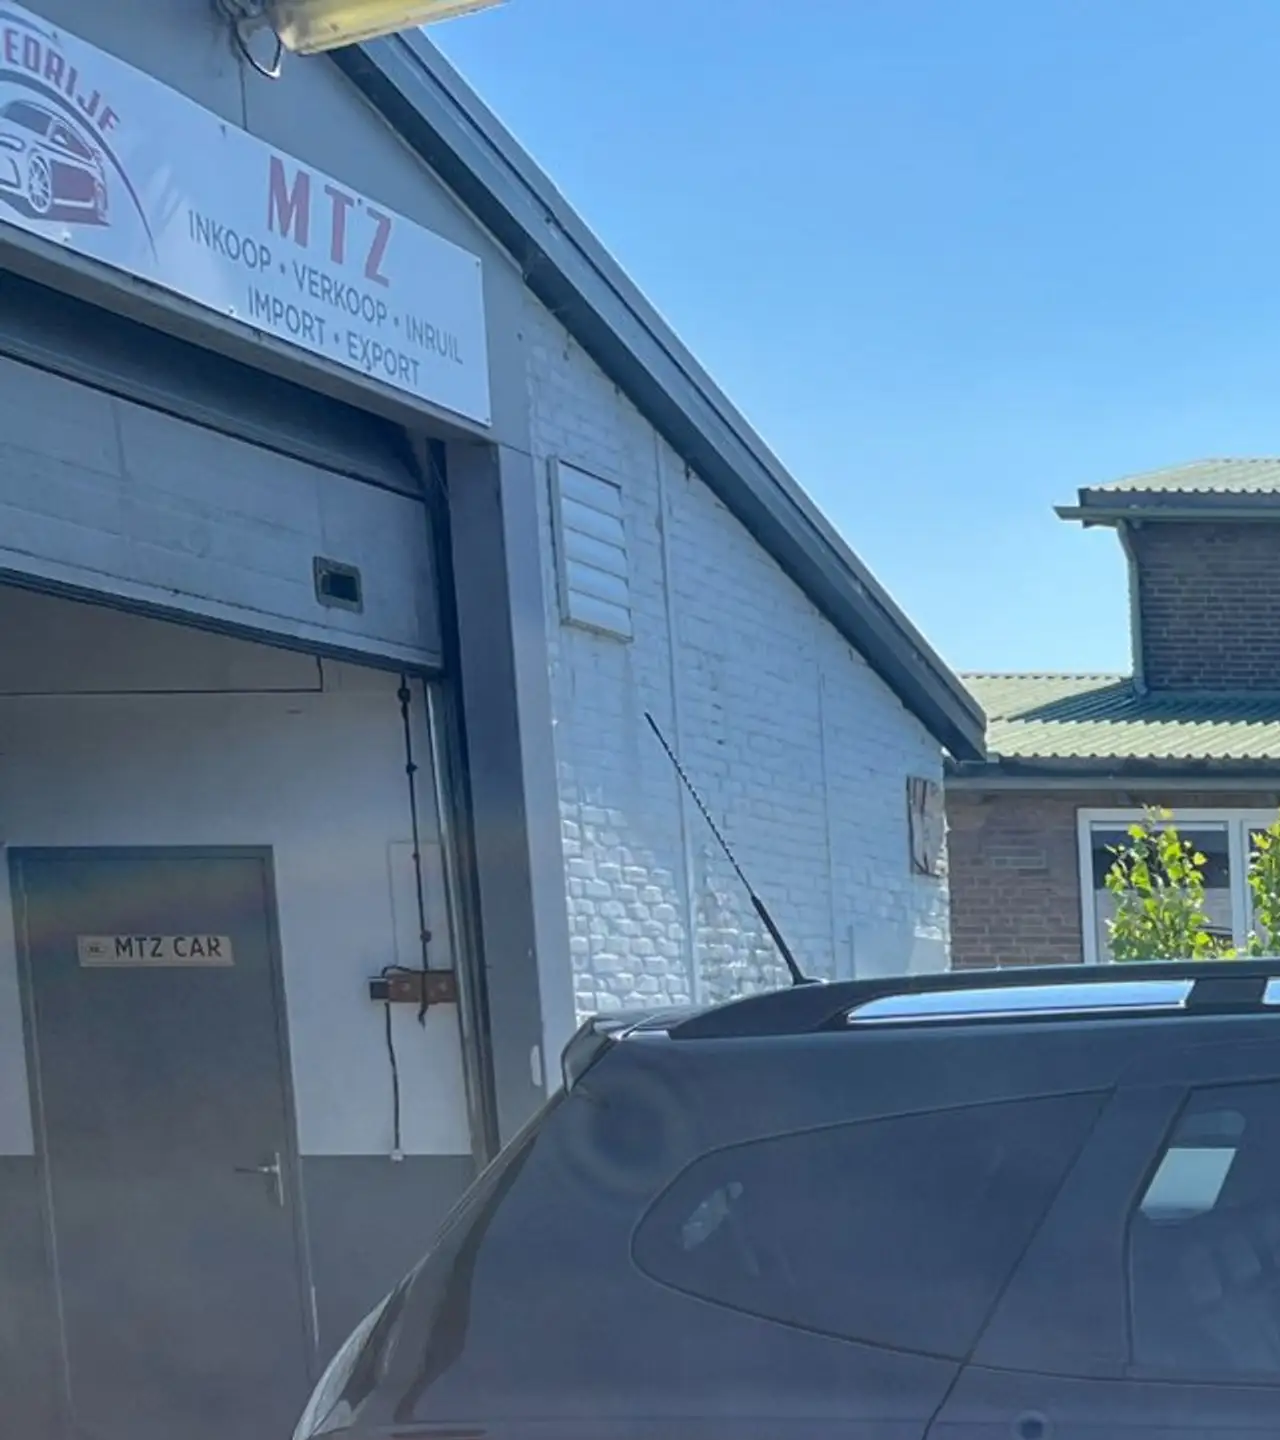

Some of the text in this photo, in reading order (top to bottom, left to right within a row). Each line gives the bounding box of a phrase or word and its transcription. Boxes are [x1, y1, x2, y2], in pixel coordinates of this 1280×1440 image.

[268, 155, 392, 288] MTZ
[189, 210, 463, 365] INKOOP VERKOOP INRUIL
[249, 287, 420, 386] IMPORT EXPORT
[114, 936, 164, 959] MTZ
[173, 936, 222, 958] CAR
